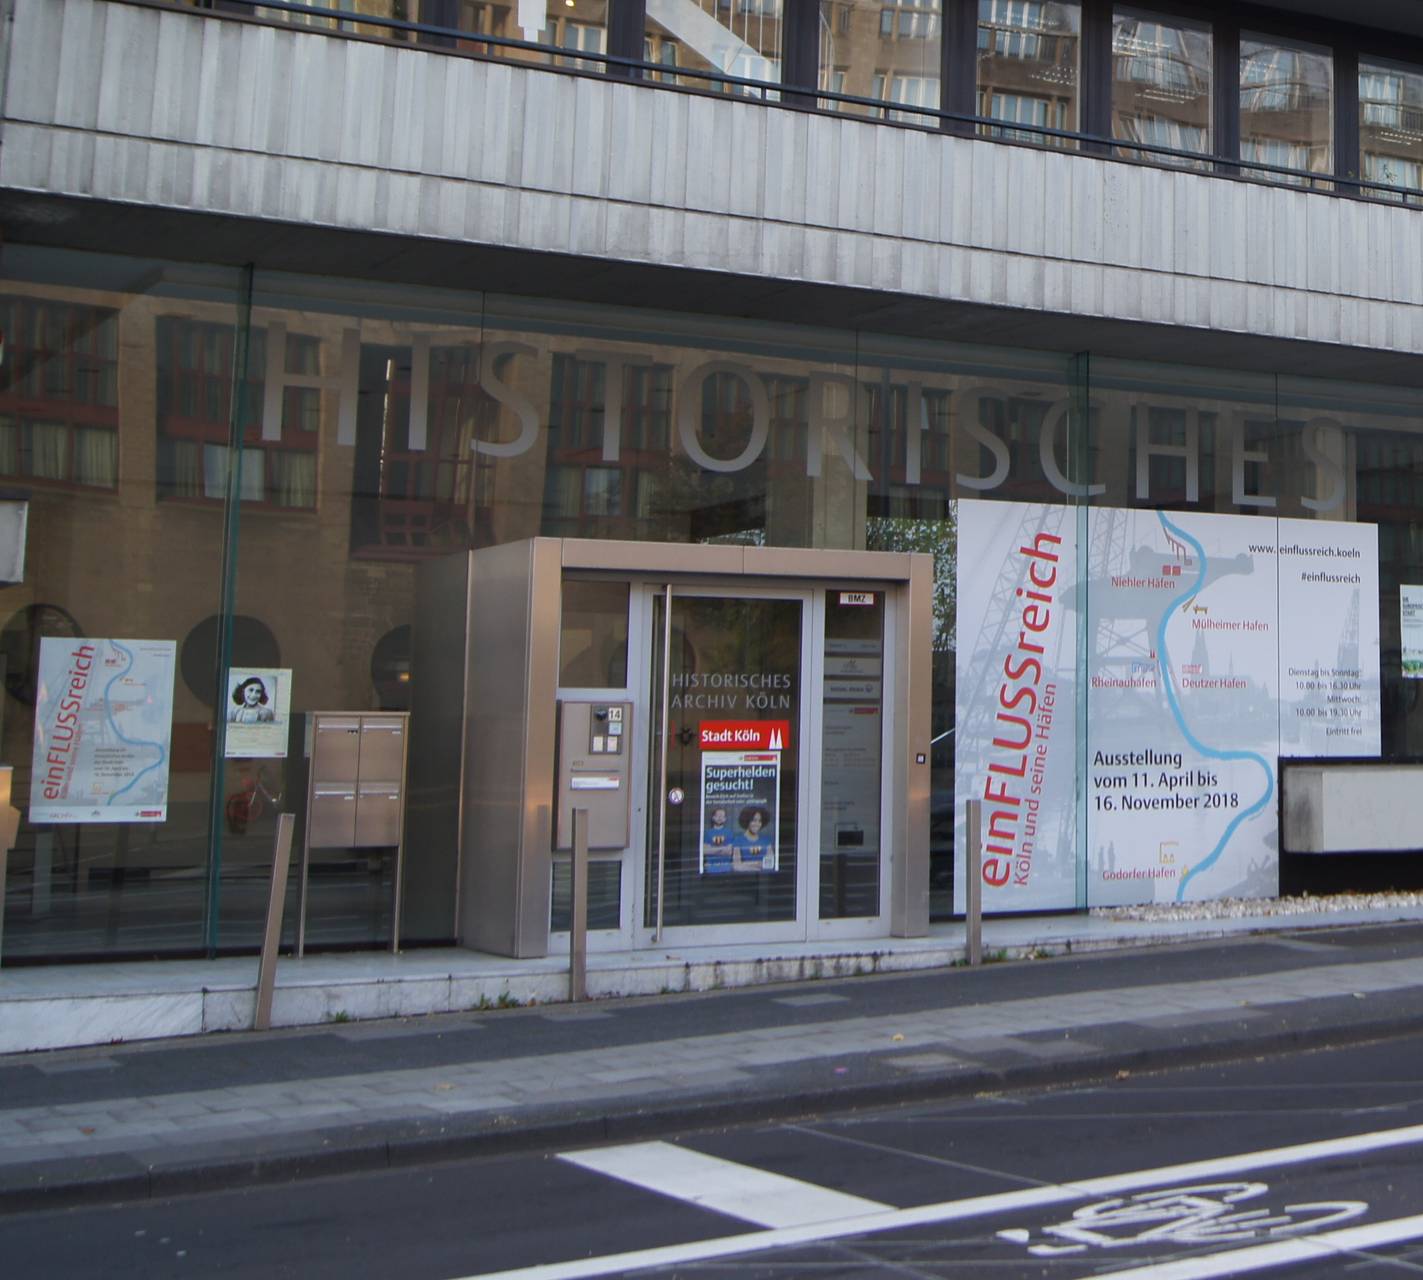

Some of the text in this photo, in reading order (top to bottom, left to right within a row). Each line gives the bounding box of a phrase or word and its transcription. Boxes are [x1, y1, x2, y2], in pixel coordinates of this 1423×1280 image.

[262, 320, 1347, 512] HISTORISCHES
[1111, 576, 1145, 588] Niehler
[1301, 571, 1361, 584] #einflussreich
[1192, 618, 1269, 632] Mülheimer Hafen
[1288, 667, 1319, 679] Dienstag
[1320, 667, 1330, 677] bis
[672, 673, 791, 689] HISTORISCHES
[1182, 677, 1247, 689] Deutzer Hafen
[1296, 681, 1315, 690] 10.00
[1317, 681, 1327, 690] bis
[1349, 681, 1361, 691] Uhr
[671, 691, 790, 709] ARCHIV KÖLN
[610, 709, 621, 720] 14
[981, 532, 1062, 888] einFLUSSreich
[1296, 707, 1316, 718] 10.00
[1317, 707, 1328, 717] bis
[1349, 707, 1362, 717] Uhr
[41, 644, 96, 800] einFLUSSreich
[702, 728, 760, 742] Stadt Köln
[1325, 727, 1362, 737] Eintritt frei
[1093, 749, 1182, 769] Ausstellung
[706, 765, 776, 781] Superhelden
[1094, 770, 1218, 791] vom 11. April bis
[706, 778, 754, 794] gesucht!
[1013, 683, 1057, 886] Köln und seine Häfen
[1095, 792, 1239, 811] 16. November 2018
[1102, 867, 1176, 881] Godorfer Hafen
